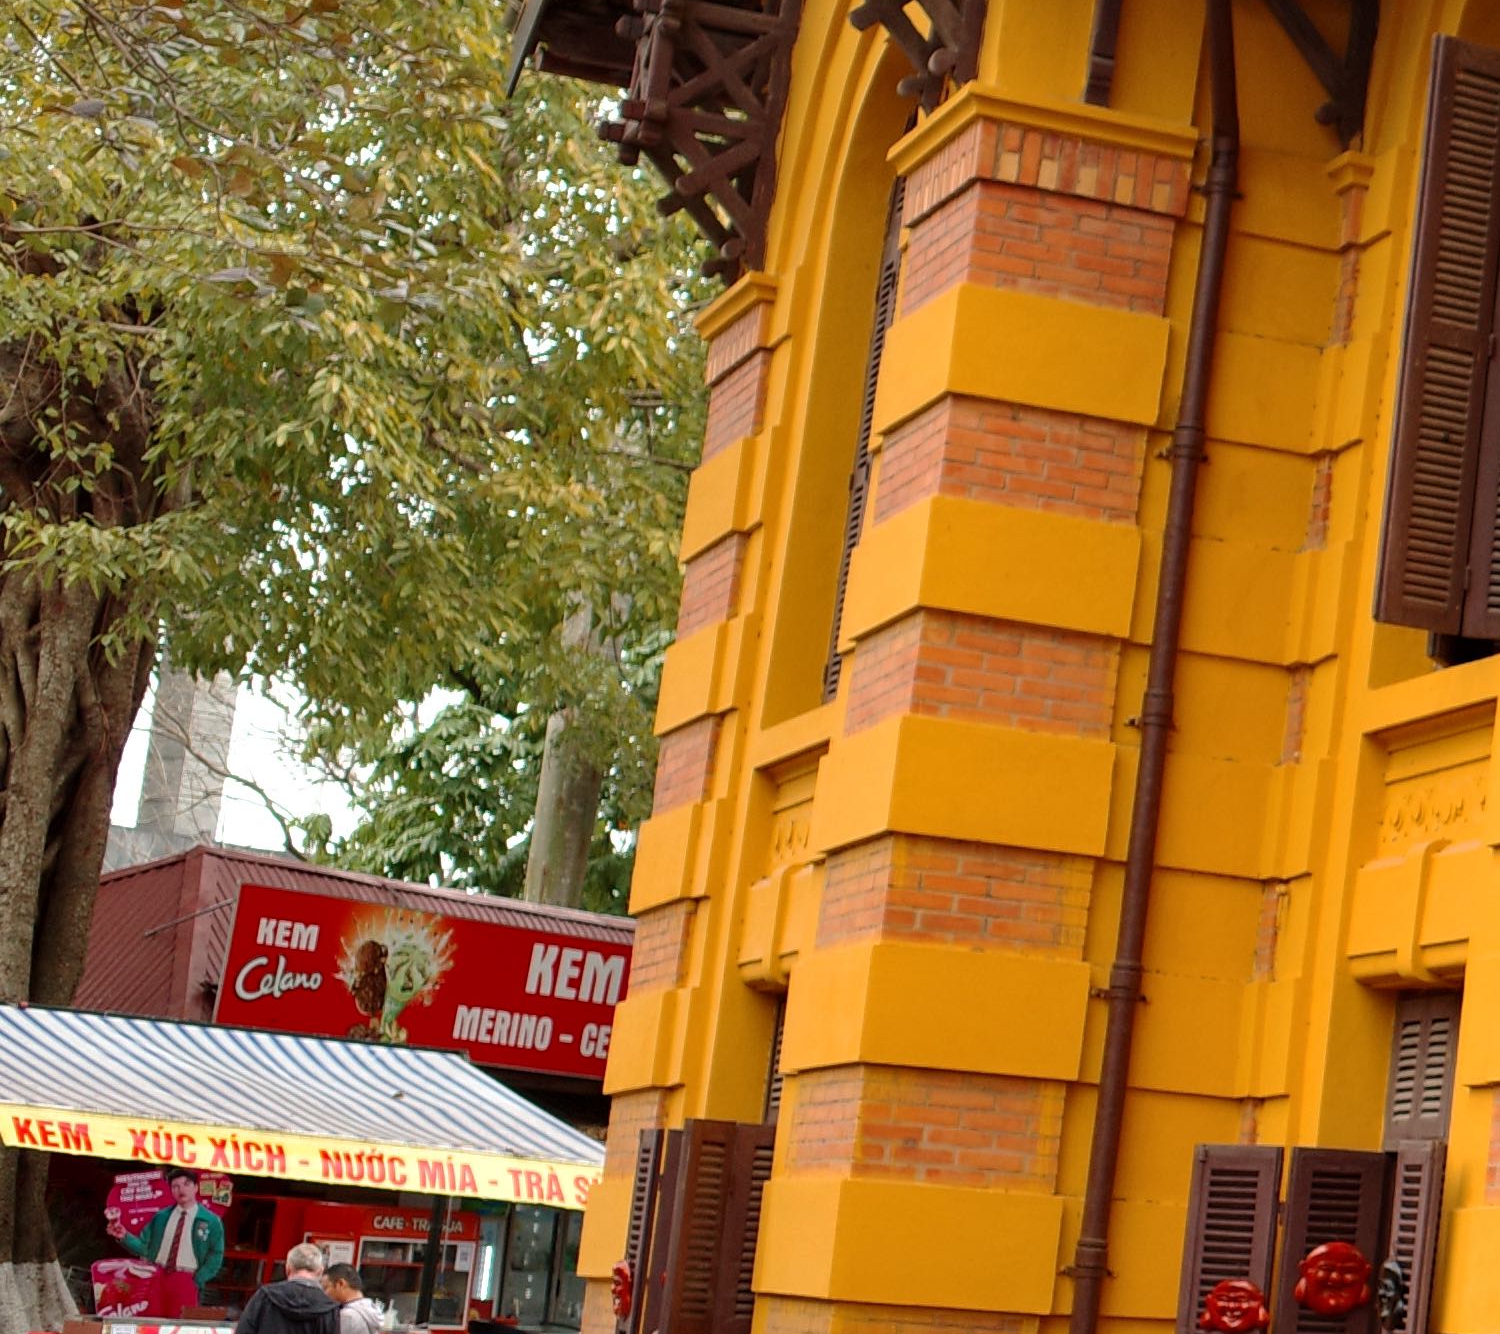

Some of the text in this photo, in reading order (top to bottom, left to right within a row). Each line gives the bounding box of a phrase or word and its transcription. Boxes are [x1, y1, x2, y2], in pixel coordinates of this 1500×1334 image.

[256, 917, 320, 952] KEM
[235, 954, 323, 1001] Celano
[525, 942, 626, 1006] KEM
[452, 1004, 553, 1052] MERINO
[12, 1116, 93, 1151] KEM
[128, 1125, 197, 1164] XÚC
[208, 1133, 287, 1174] XÍCH
[319, 1148, 407, 1186] NƯỚC
[417, 1156, 479, 1193] MÍA
[507, 1167, 565, 1203] TRÀ
